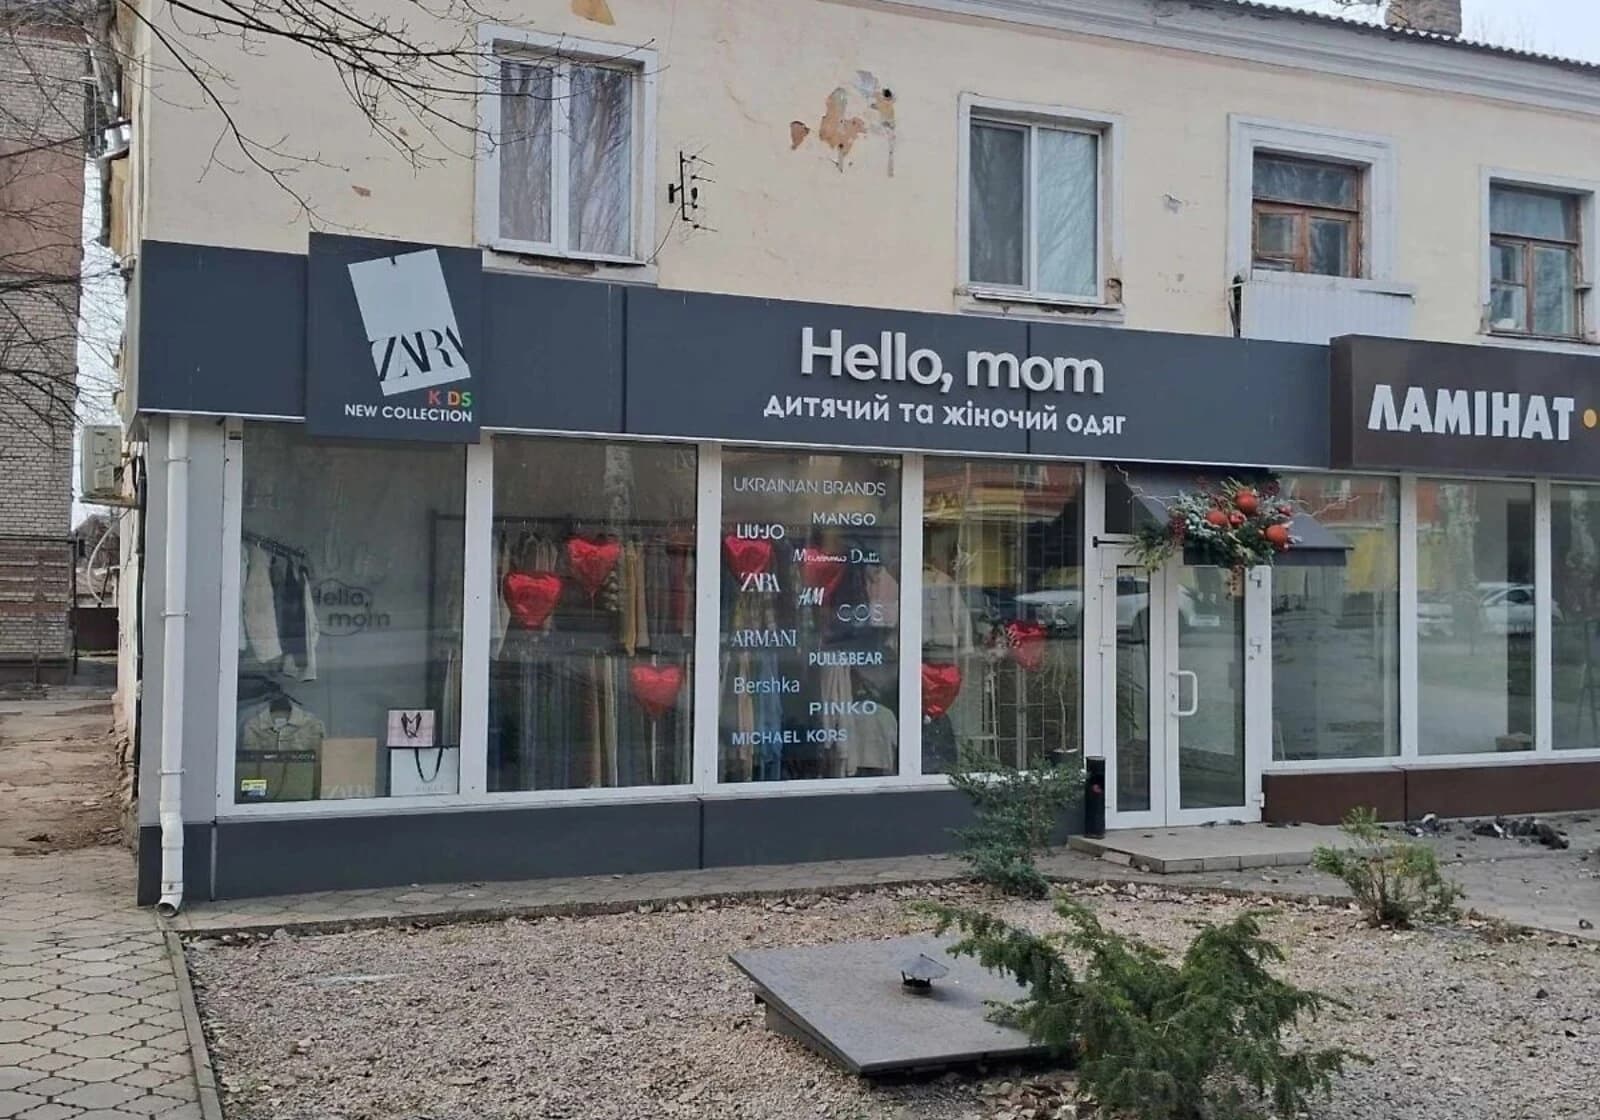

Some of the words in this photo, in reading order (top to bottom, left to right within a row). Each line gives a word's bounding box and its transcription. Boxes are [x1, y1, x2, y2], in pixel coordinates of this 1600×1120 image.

[369, 325, 467, 382] ZARA
[801, 327, 954, 393] Hello,
[967, 351, 1105, 393] mom
[345, 404, 378, 417] NEW
[382, 406, 473, 423] COLLECTION
[899, 403, 933, 424] та
[942, 401, 1057, 431] жіночий
[1066, 413, 1126, 436] одяг
[1368, 384, 1575, 441] ЛАМІНАТ
[733, 477, 819, 494] UKRAINIAN
[823, 480, 887, 496] BRANDS
[812, 512, 876, 526] MANGO
[740, 572, 780, 593] ZARA
[836, 604, 883, 622] COS
[732, 629, 797, 648] ARMANI
[809, 651, 883, 666] PULL&BEAR
[733, 677, 801, 694] Bershka
[809, 701, 878, 716] PINKO
[732, 731, 800, 746] MICHAEL
[806, 729, 848, 744] KORS
